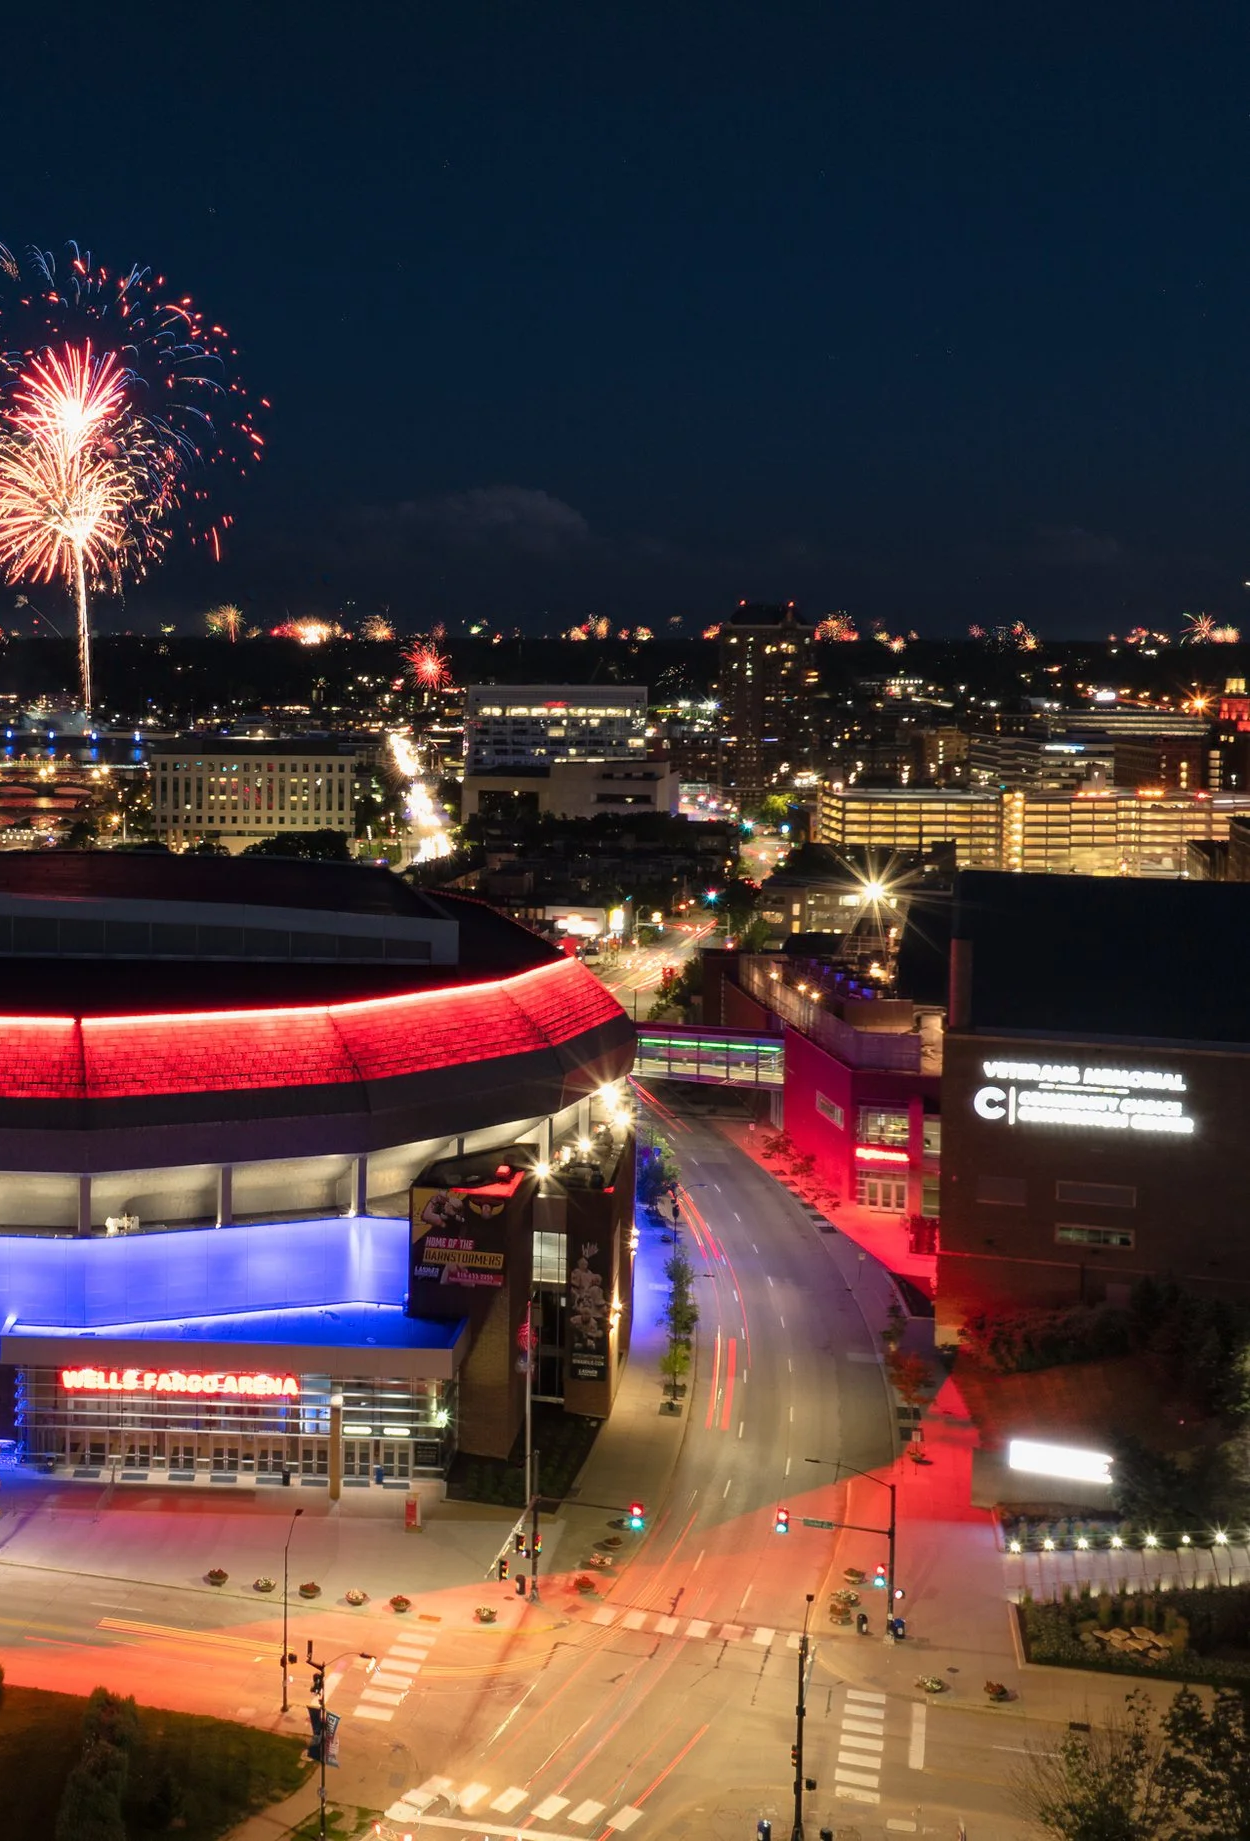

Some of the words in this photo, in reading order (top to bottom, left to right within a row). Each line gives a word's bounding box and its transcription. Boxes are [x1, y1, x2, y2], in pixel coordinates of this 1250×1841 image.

[983, 1061, 1080, 1084] VETERANS
[1083, 1067, 1187, 1091] MEMORIAL
[425, 1236, 446, 1248] HOME
[447, 1238, 458, 1249] OF
[459, 1240, 474, 1250] THE
[424, 1249, 502, 1267] BARNSTORMERS
[61, 1369, 137, 1390] WELLS
[144, 1372, 219, 1393] FARGO
[223, 1375, 299, 1396] ARENA
